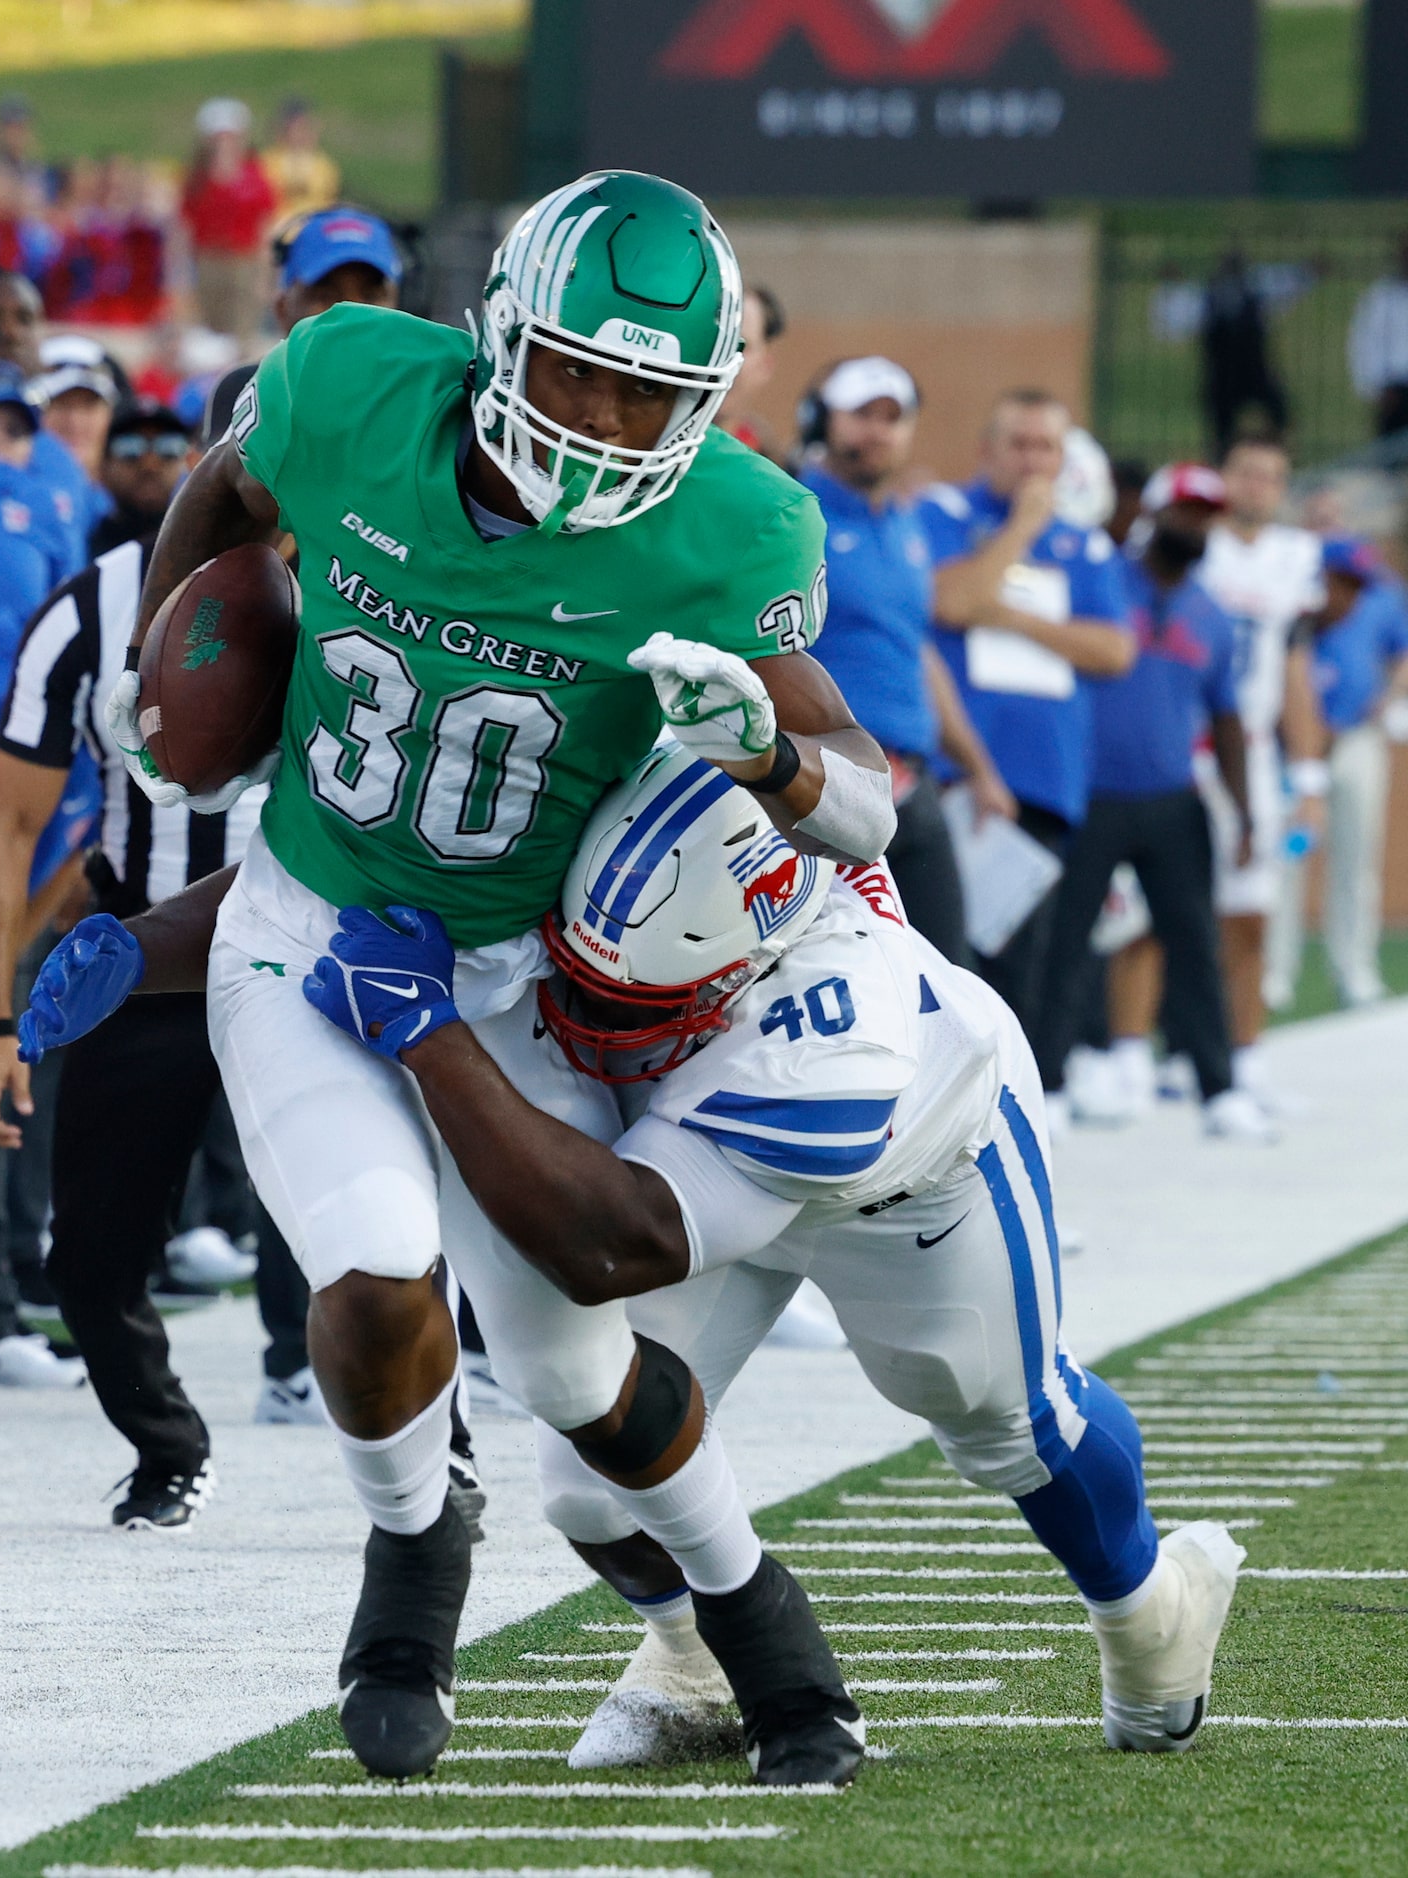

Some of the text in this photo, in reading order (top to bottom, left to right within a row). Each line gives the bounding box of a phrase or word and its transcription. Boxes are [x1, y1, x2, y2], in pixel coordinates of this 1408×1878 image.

[622, 325, 665, 350] UNT
[326, 555, 587, 685] MEAN GREEN
[304, 624, 568, 865] 30
[572, 920, 620, 964] Riddell
[759, 976, 856, 1042] 40
